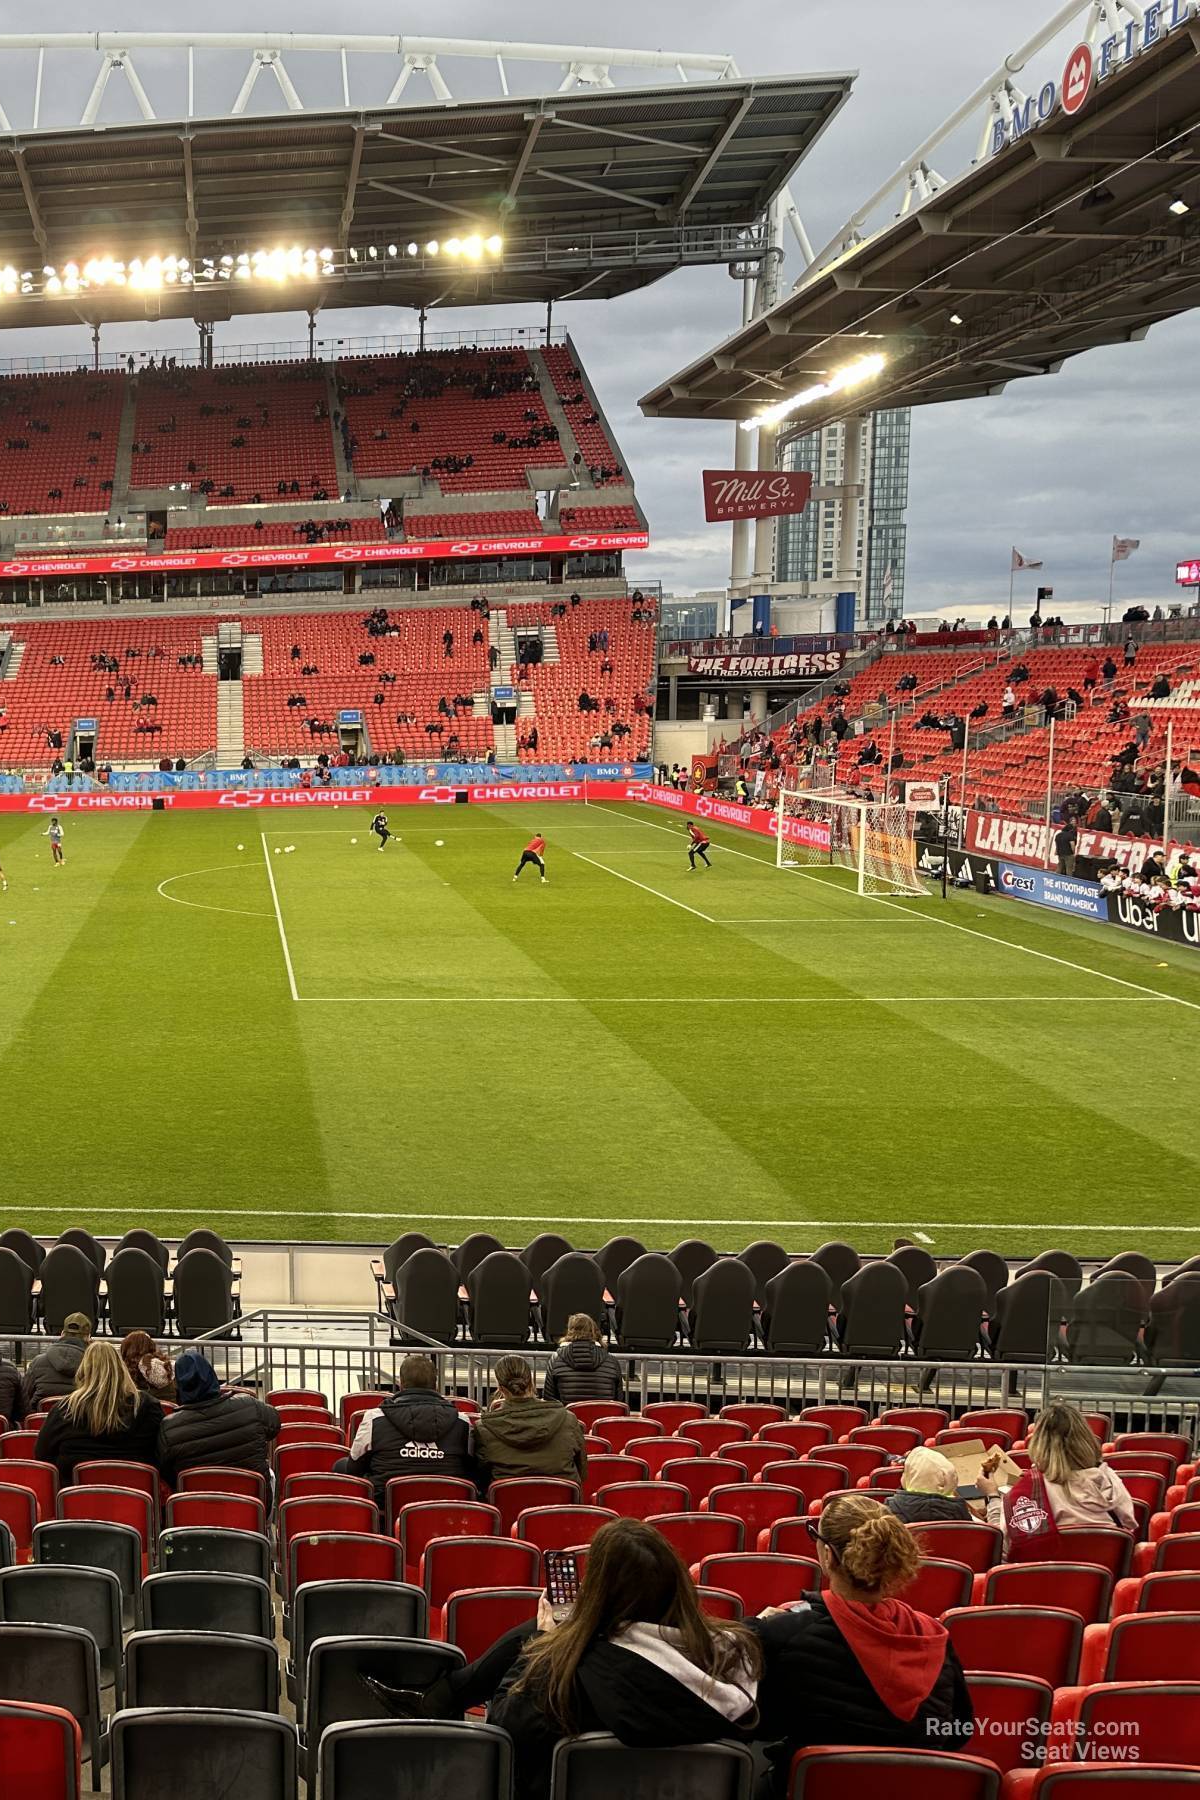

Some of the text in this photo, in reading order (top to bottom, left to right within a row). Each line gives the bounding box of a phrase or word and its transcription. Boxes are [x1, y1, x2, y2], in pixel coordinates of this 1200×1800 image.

[992, 0, 1200, 156] BMO FIEL
[711, 476, 795, 505] Mill St.
[717, 500, 788, 514] BREWERY
[365, 546, 424, 557] CHEVROLET
[482, 541, 543, 551] CHEVROLET
[140, 557, 197, 567] CHEVROLET
[251, 552, 310, 562] CHEVROLET
[32, 562, 87, 572] CHEVROLET
[691, 652, 841, 672] THE FORTRESS
[596, 767, 619, 776] BMO
[271, 791, 373, 802] CHEVROLET
[474, 786, 583, 798] CHEVROLET
[652, 790, 684, 806] CHEVROLET
[78, 795, 176, 806] CHEVROLT
[714, 804, 752, 824] CHEVROLET
[975, 816, 1096, 864] LAKESHE
[1001, 871, 1036, 892] Crest
[1042, 877, 1054, 888] THE
[1061, 881, 1099, 899] TOOTHPASTE
[1043, 890, 1064, 904] BRAND
[1071, 897, 1099, 912] AMERICA
[400, 1446, 445, 1459] adidas
